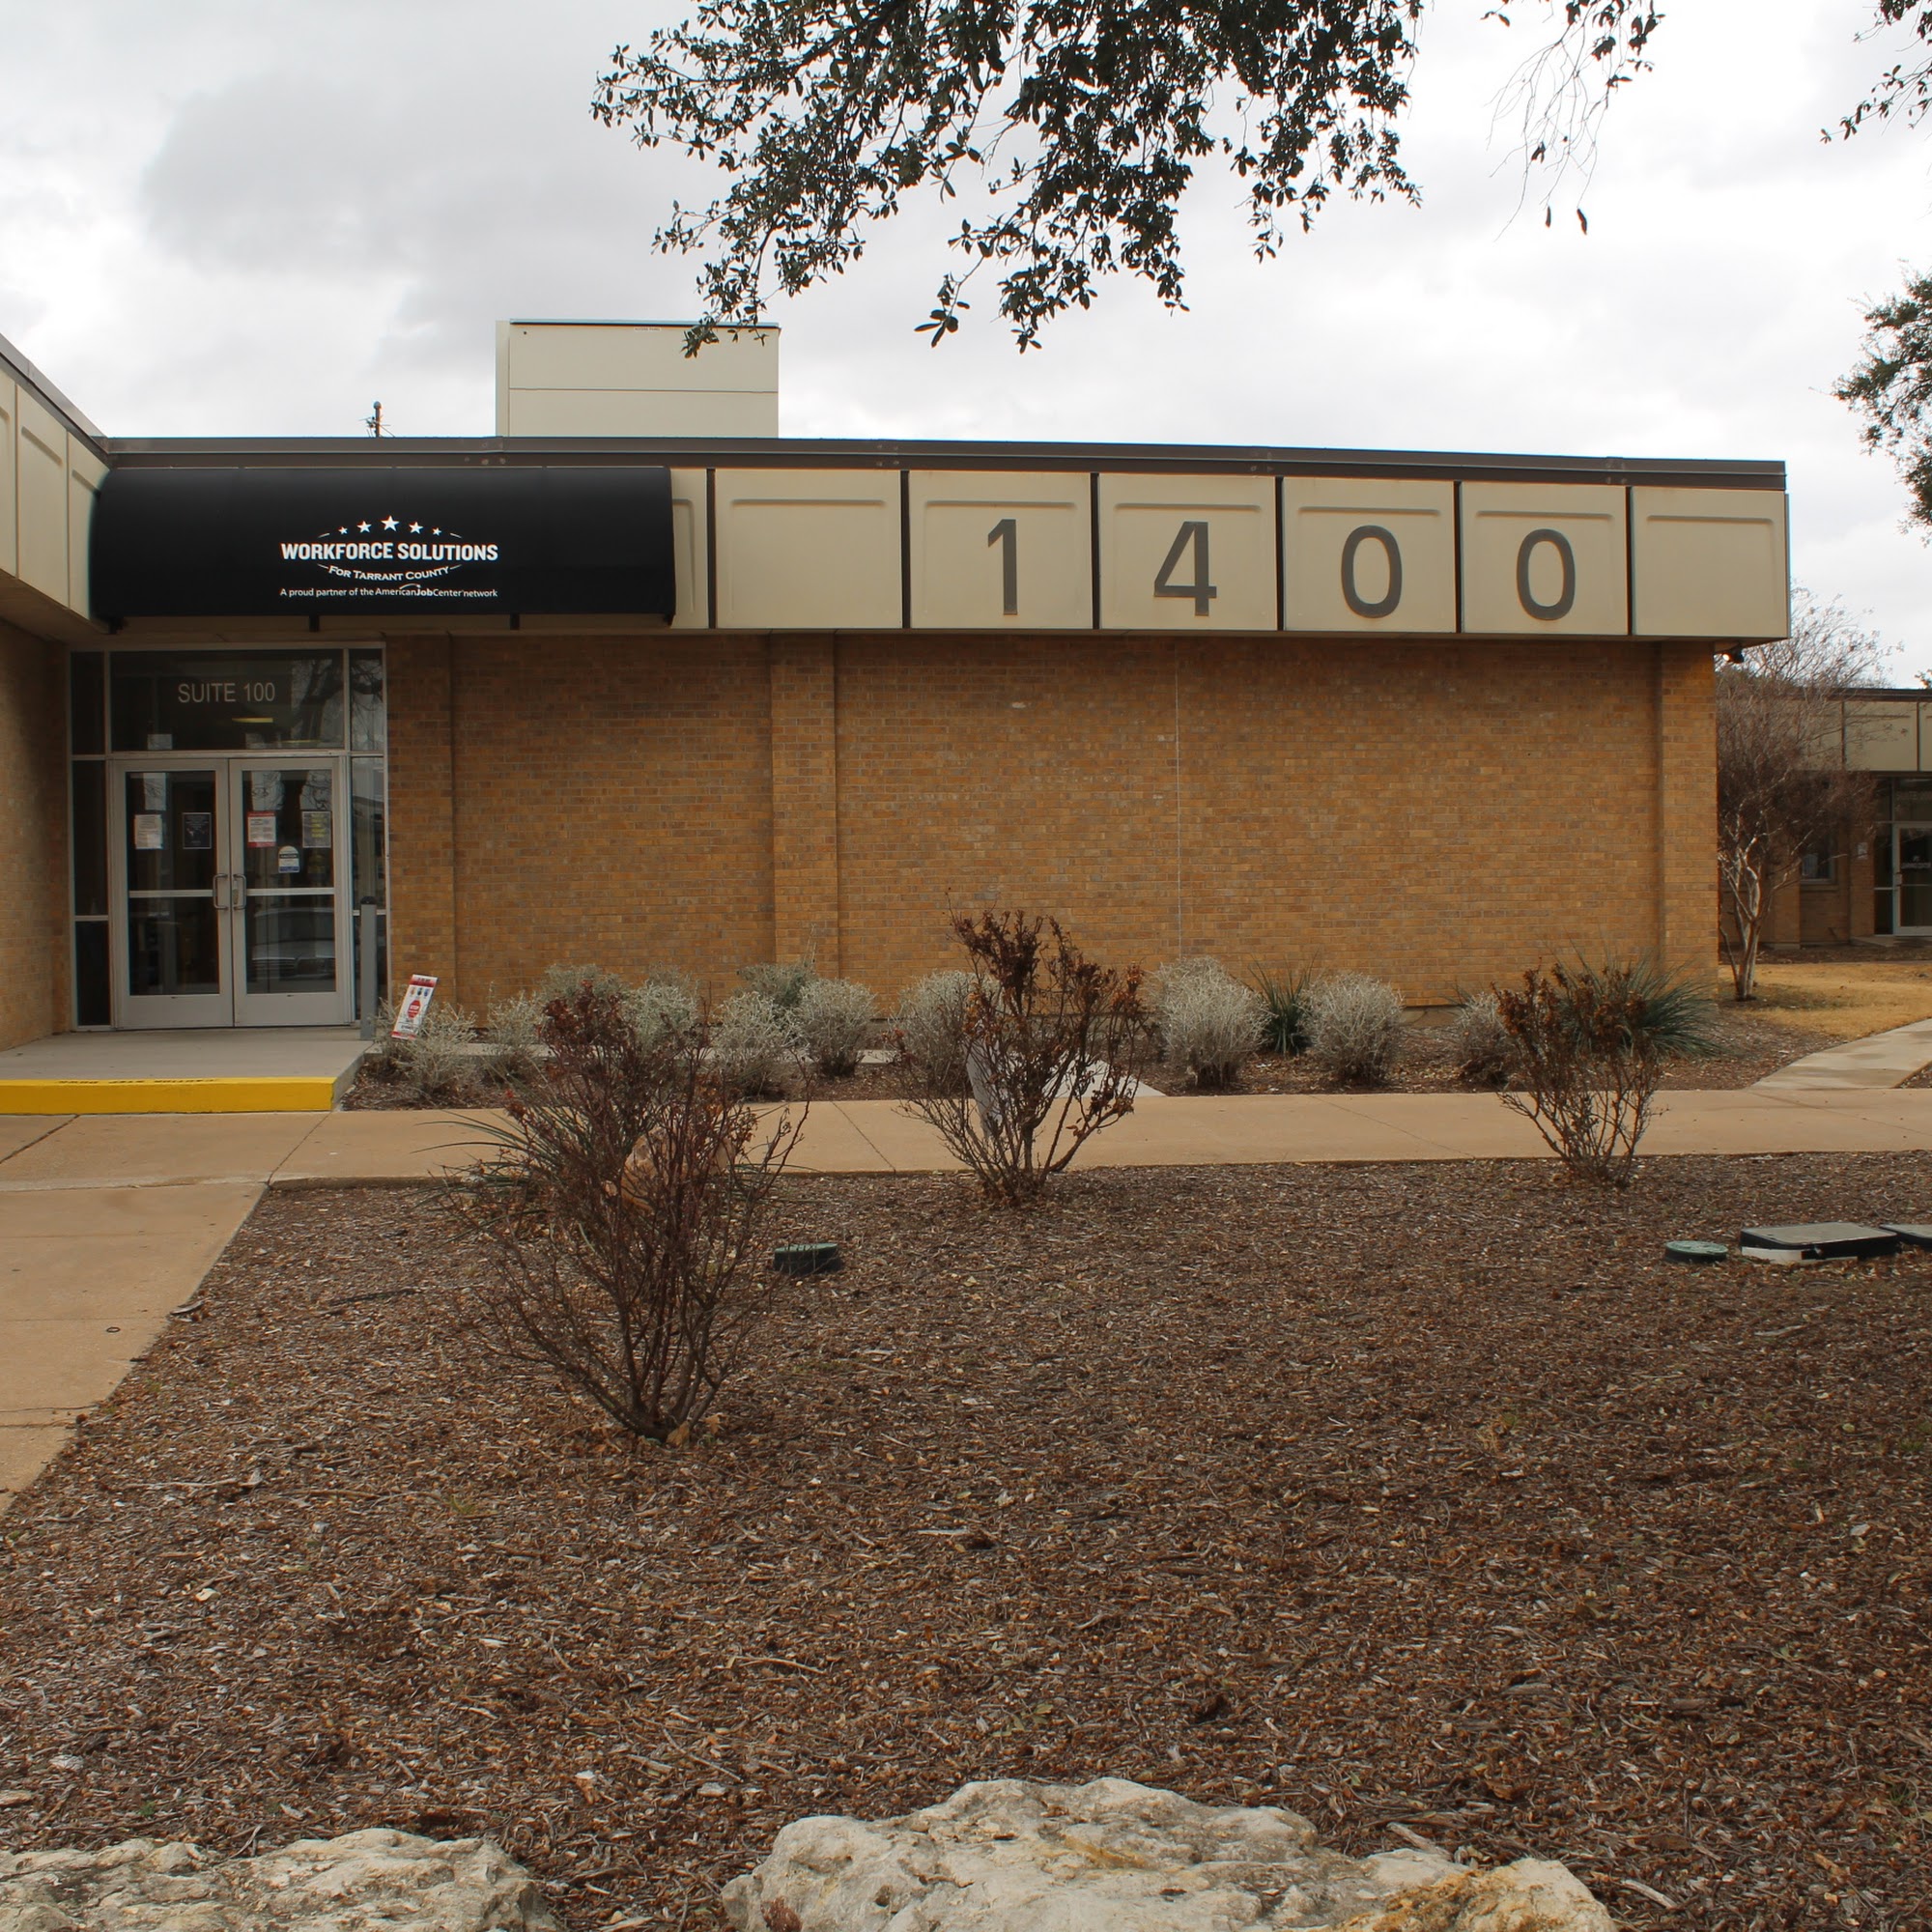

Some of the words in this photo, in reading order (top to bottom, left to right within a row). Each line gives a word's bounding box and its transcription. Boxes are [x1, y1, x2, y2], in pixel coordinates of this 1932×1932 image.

[281, 542, 394, 560] WORKFORCE
[397, 543, 498, 561] SOLUTIONS
[328, 565, 352, 579] FOR
[353, 569, 404, 582] TARRANT
[406, 566, 450, 581] COUNTY
[289, 587, 314, 598] proud
[316, 588, 347, 598] partner
[349, 587, 358, 596] of
[359, 587, 374, 596] the
[178, 682, 237, 703] SUITE
[243, 682, 275, 702] 100
